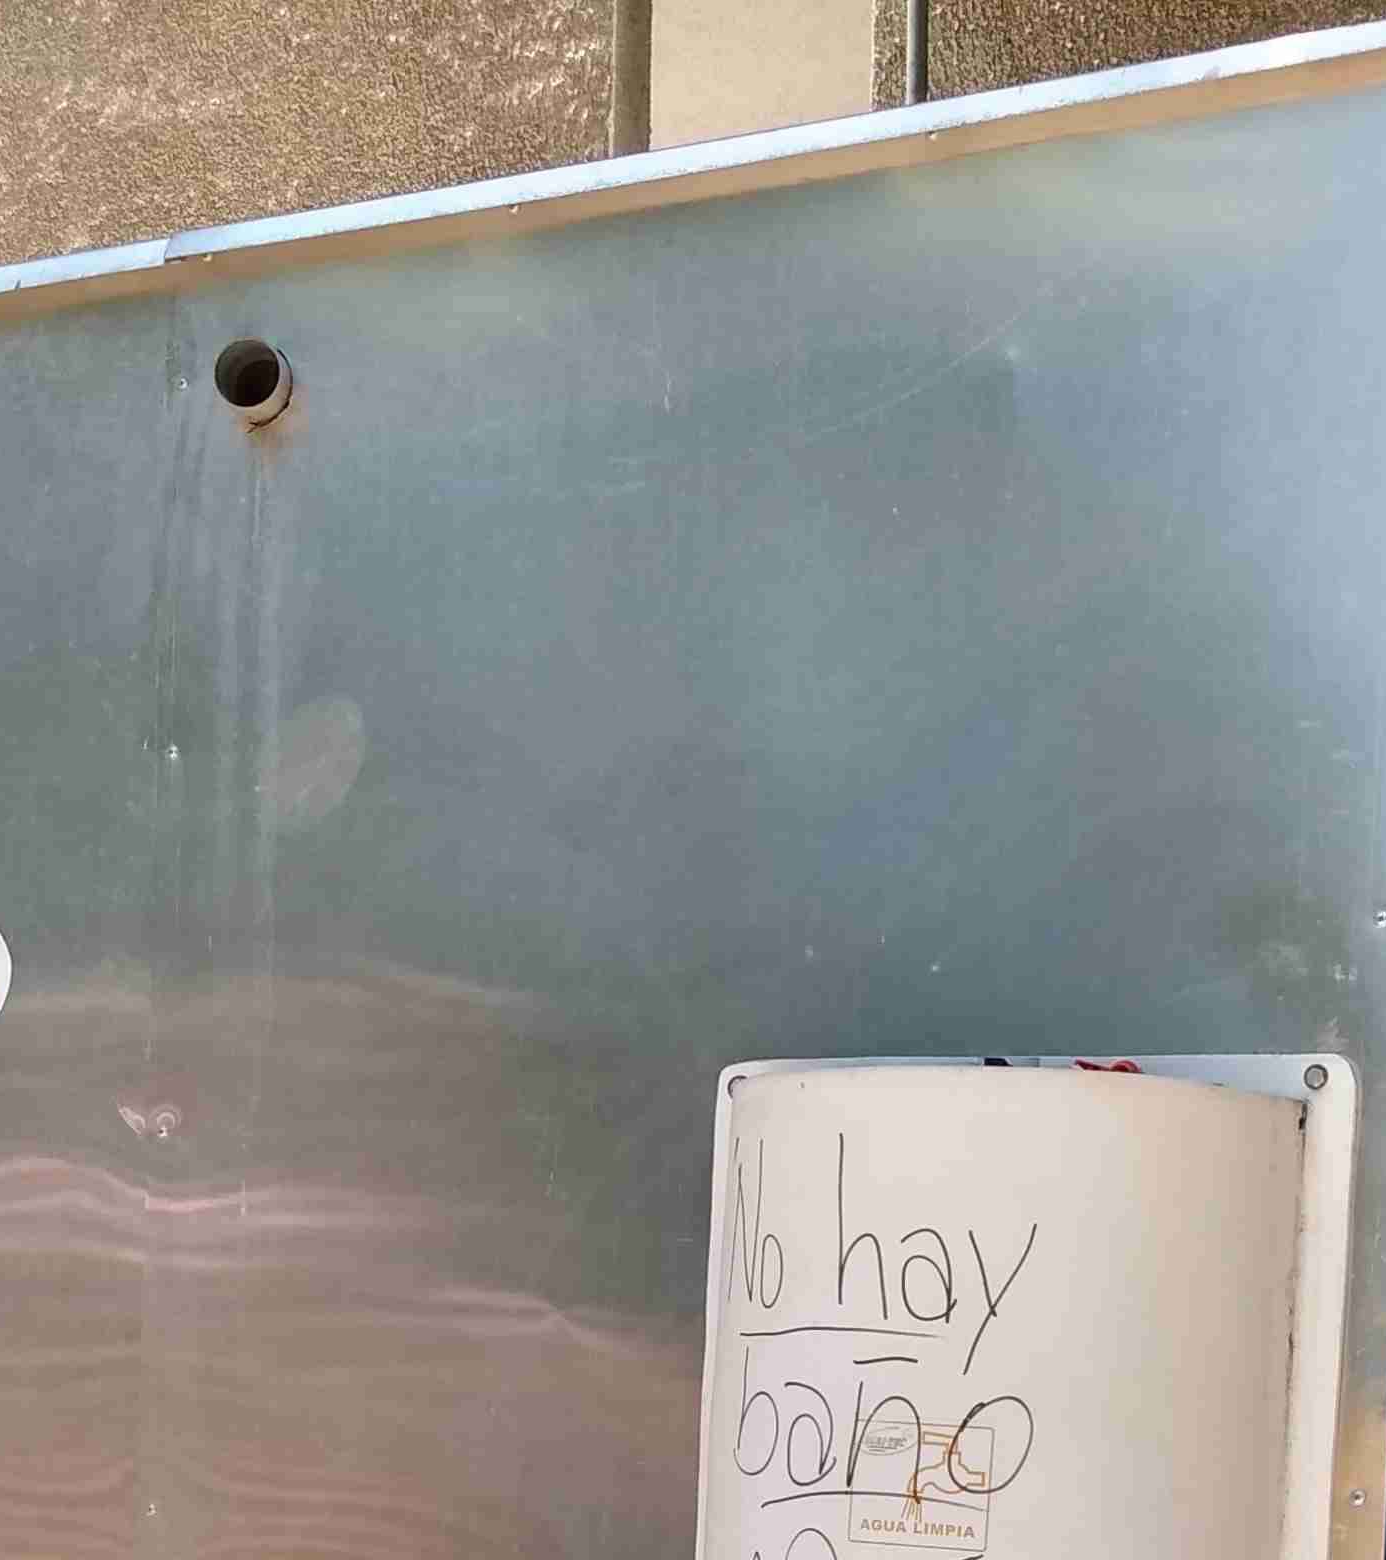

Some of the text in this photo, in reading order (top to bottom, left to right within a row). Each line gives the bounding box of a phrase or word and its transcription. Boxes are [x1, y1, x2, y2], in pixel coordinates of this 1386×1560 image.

[838, 1132, 1037, 1375] hay
[861, 1519, 975, 1538] AGUA LIMPIA
